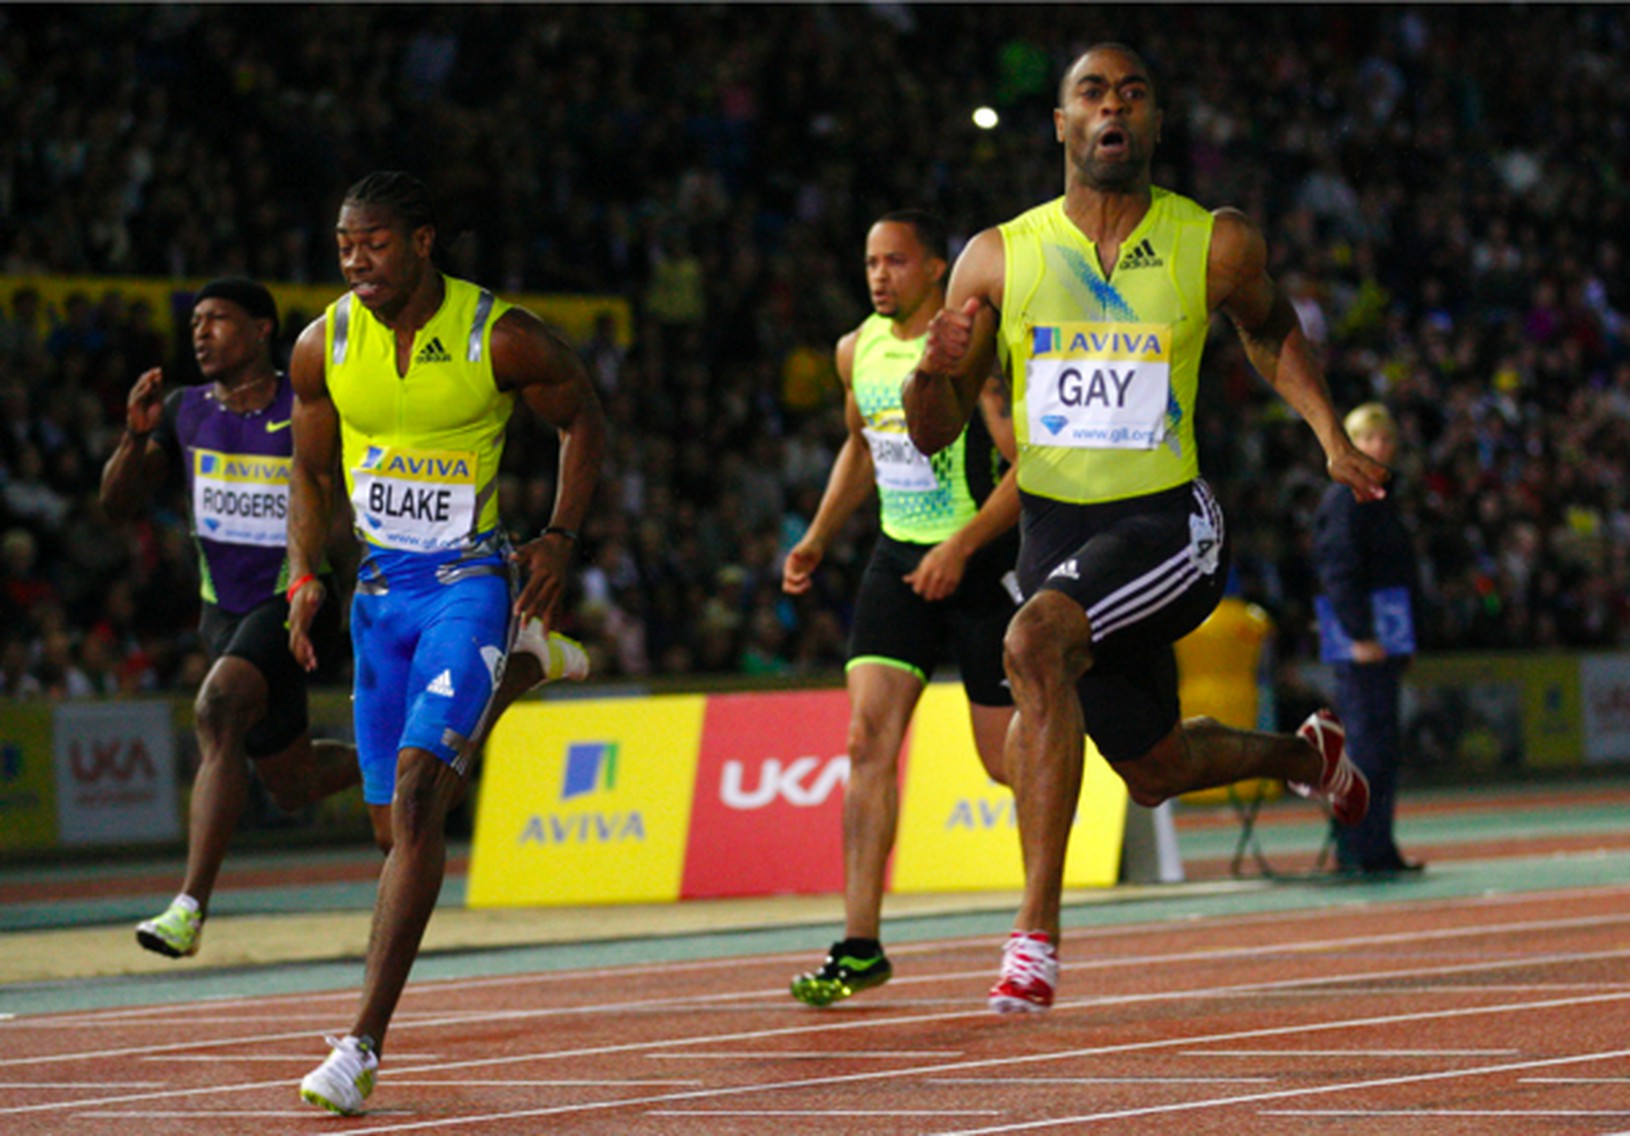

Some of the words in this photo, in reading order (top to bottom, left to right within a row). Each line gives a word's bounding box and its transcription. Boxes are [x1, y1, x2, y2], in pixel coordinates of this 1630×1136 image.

[1069, 332, 1161, 354] AVIVA
[1058, 367, 1135, 408] GAY
[224, 462, 289, 479] AVIVA
[388, 455, 469, 477] AVIVA
[203, 486, 287, 519] RODGERS
[368, 482, 451, 522] BLAKE
[69, 738, 156, 784] UKA
[518, 811, 646, 847] AVIVA
